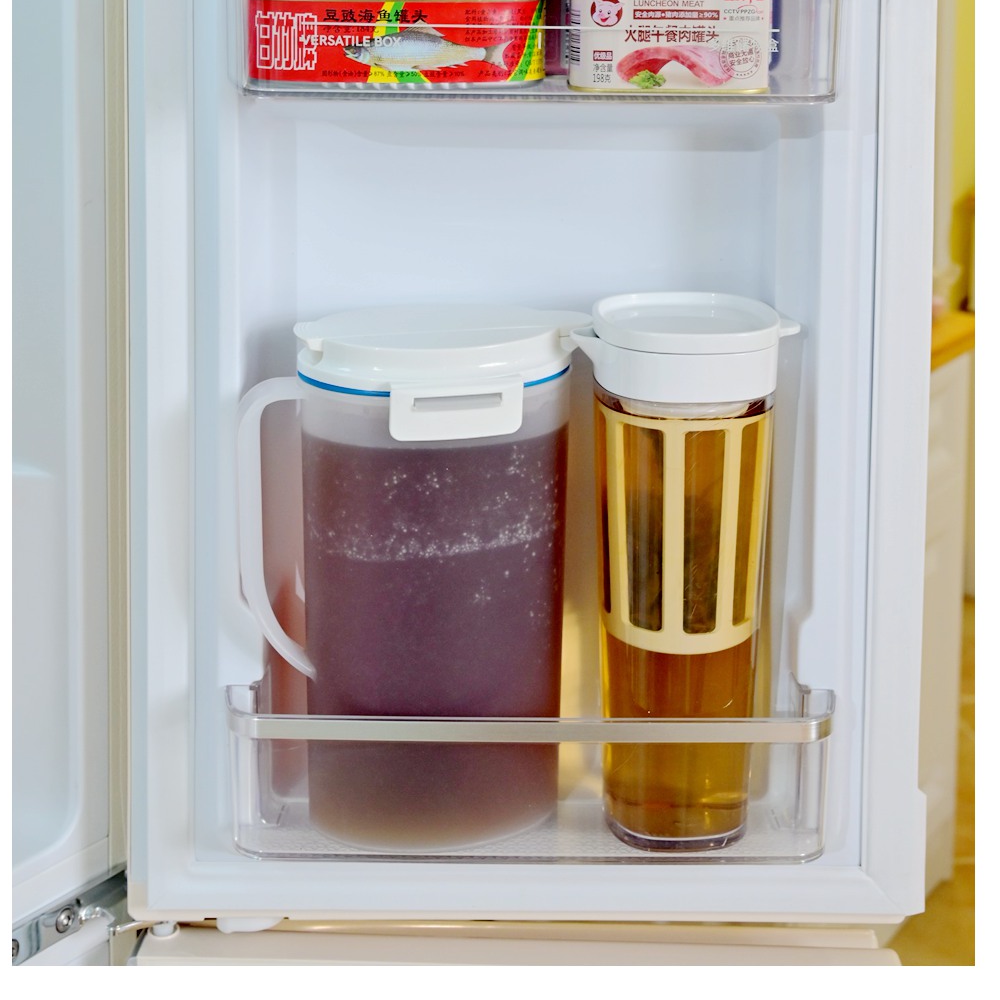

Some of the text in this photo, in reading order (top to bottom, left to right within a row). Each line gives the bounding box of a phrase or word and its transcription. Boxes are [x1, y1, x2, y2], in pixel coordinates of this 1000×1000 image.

[323, 8, 428, 23] 豆豉海鱼罐头
[624, 24, 721, 43] 火腿午餐肉罐头
[302, 34, 402, 47] VERSATILE BOX
[592, 64, 613, 73] 净含量
[592, 74, 611, 83] 198克
